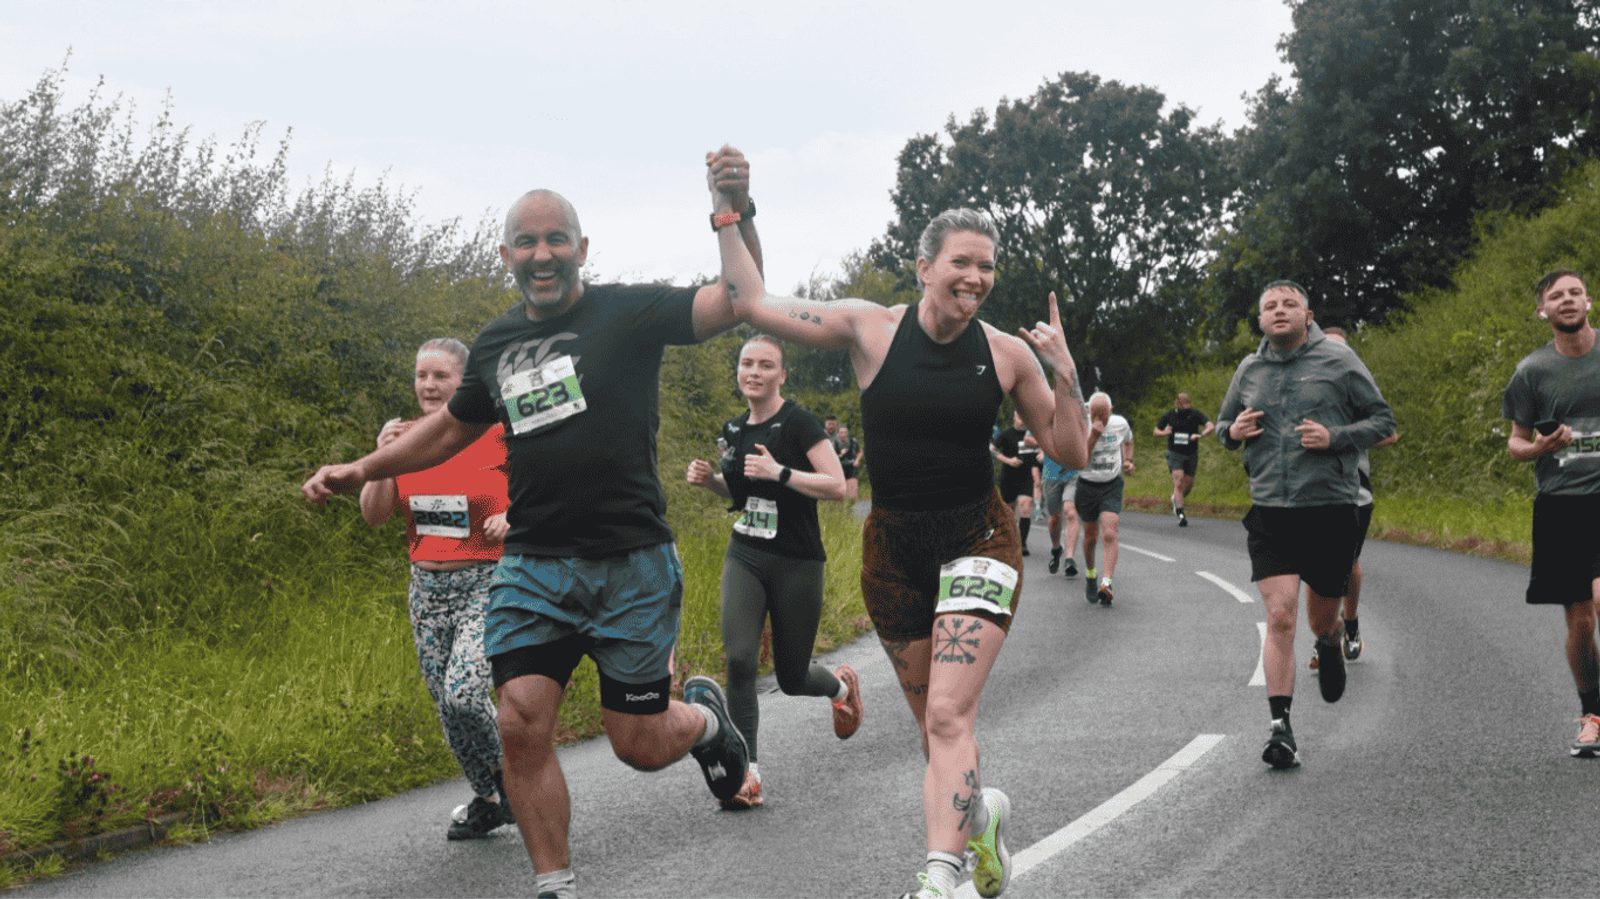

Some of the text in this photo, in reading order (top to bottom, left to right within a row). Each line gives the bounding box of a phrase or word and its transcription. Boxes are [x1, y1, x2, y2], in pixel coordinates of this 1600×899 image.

[516, 381, 569, 417] 623
[413, 510, 468, 529] 2822
[949, 575, 1003, 605] 622
